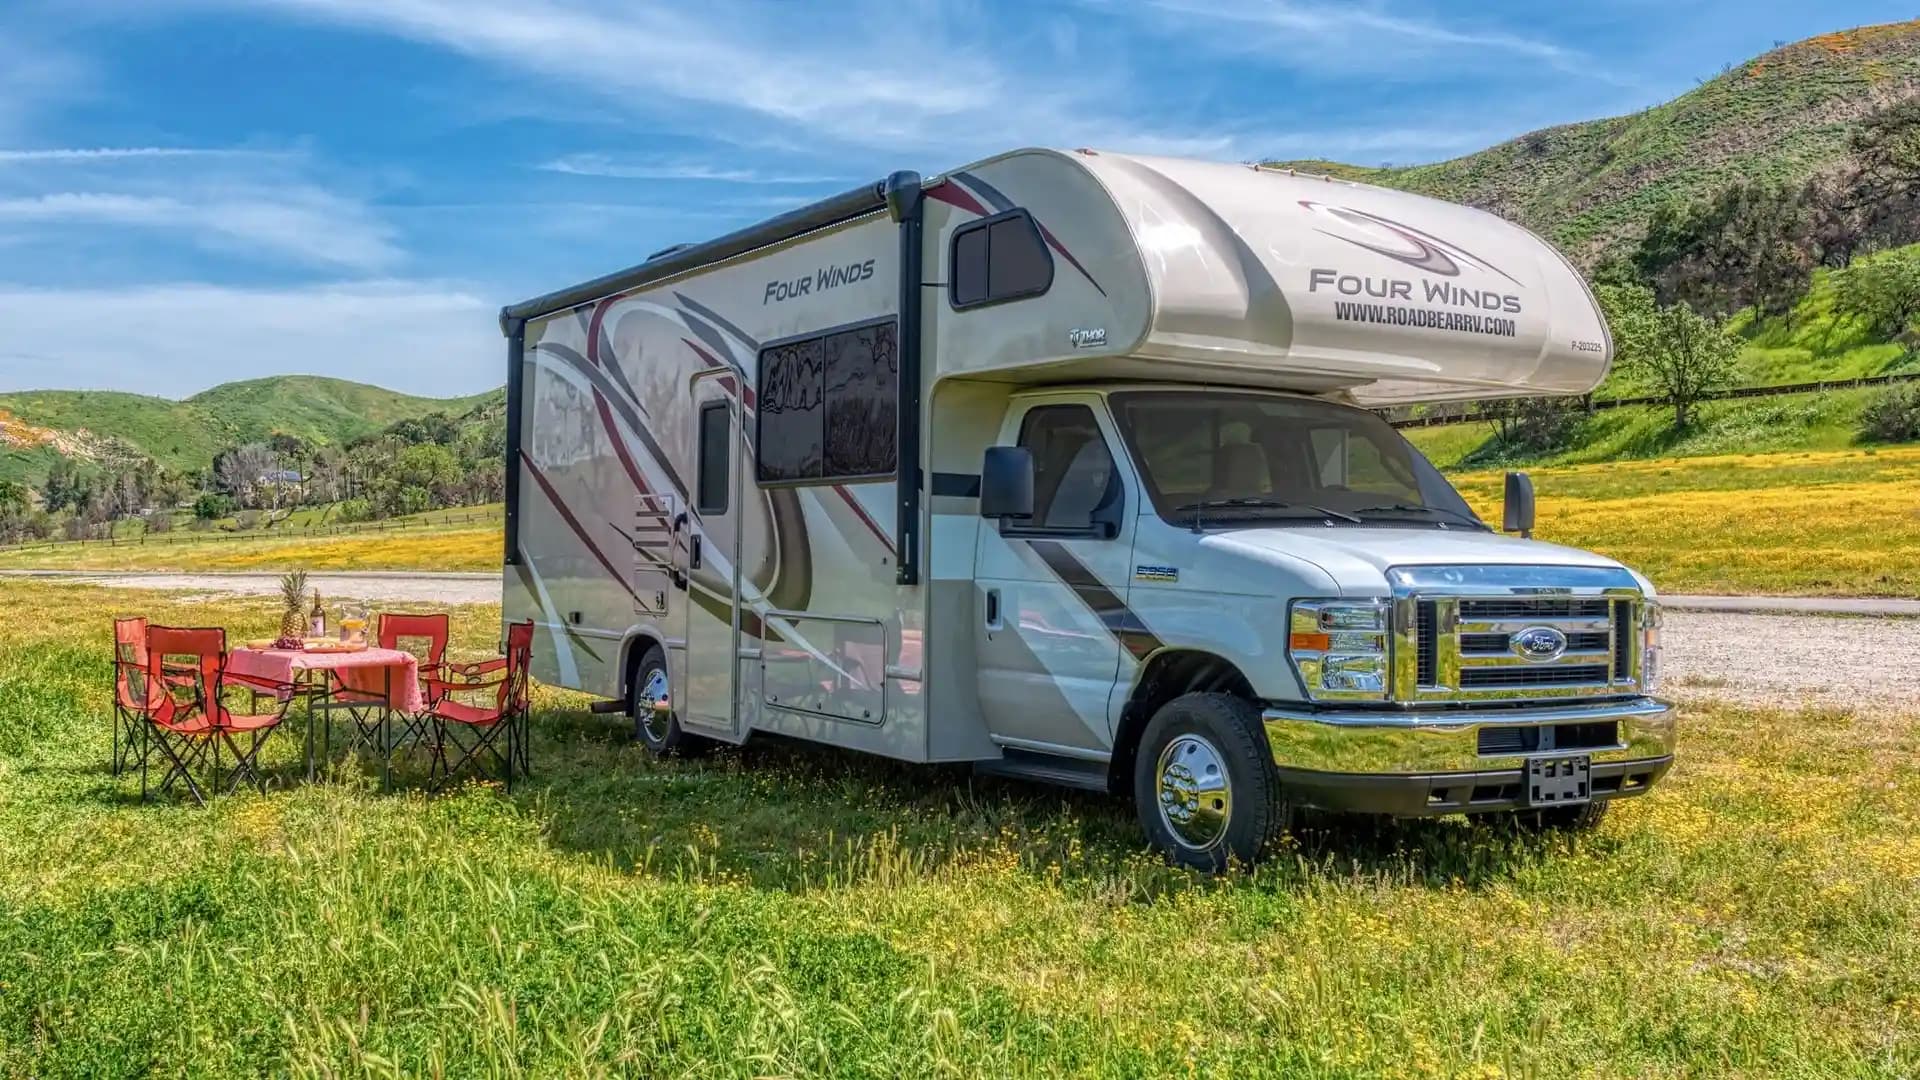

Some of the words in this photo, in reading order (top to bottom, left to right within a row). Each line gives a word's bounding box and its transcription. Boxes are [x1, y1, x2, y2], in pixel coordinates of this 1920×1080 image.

[764, 277, 812, 305] FOUR
[816, 259, 875, 291] WINDS
[1309, 268, 1413, 300] FOUR
[1422, 278, 1522, 313] WINDS
[1334, 301, 1516, 337] WWW.ROADBEARRV.COM
